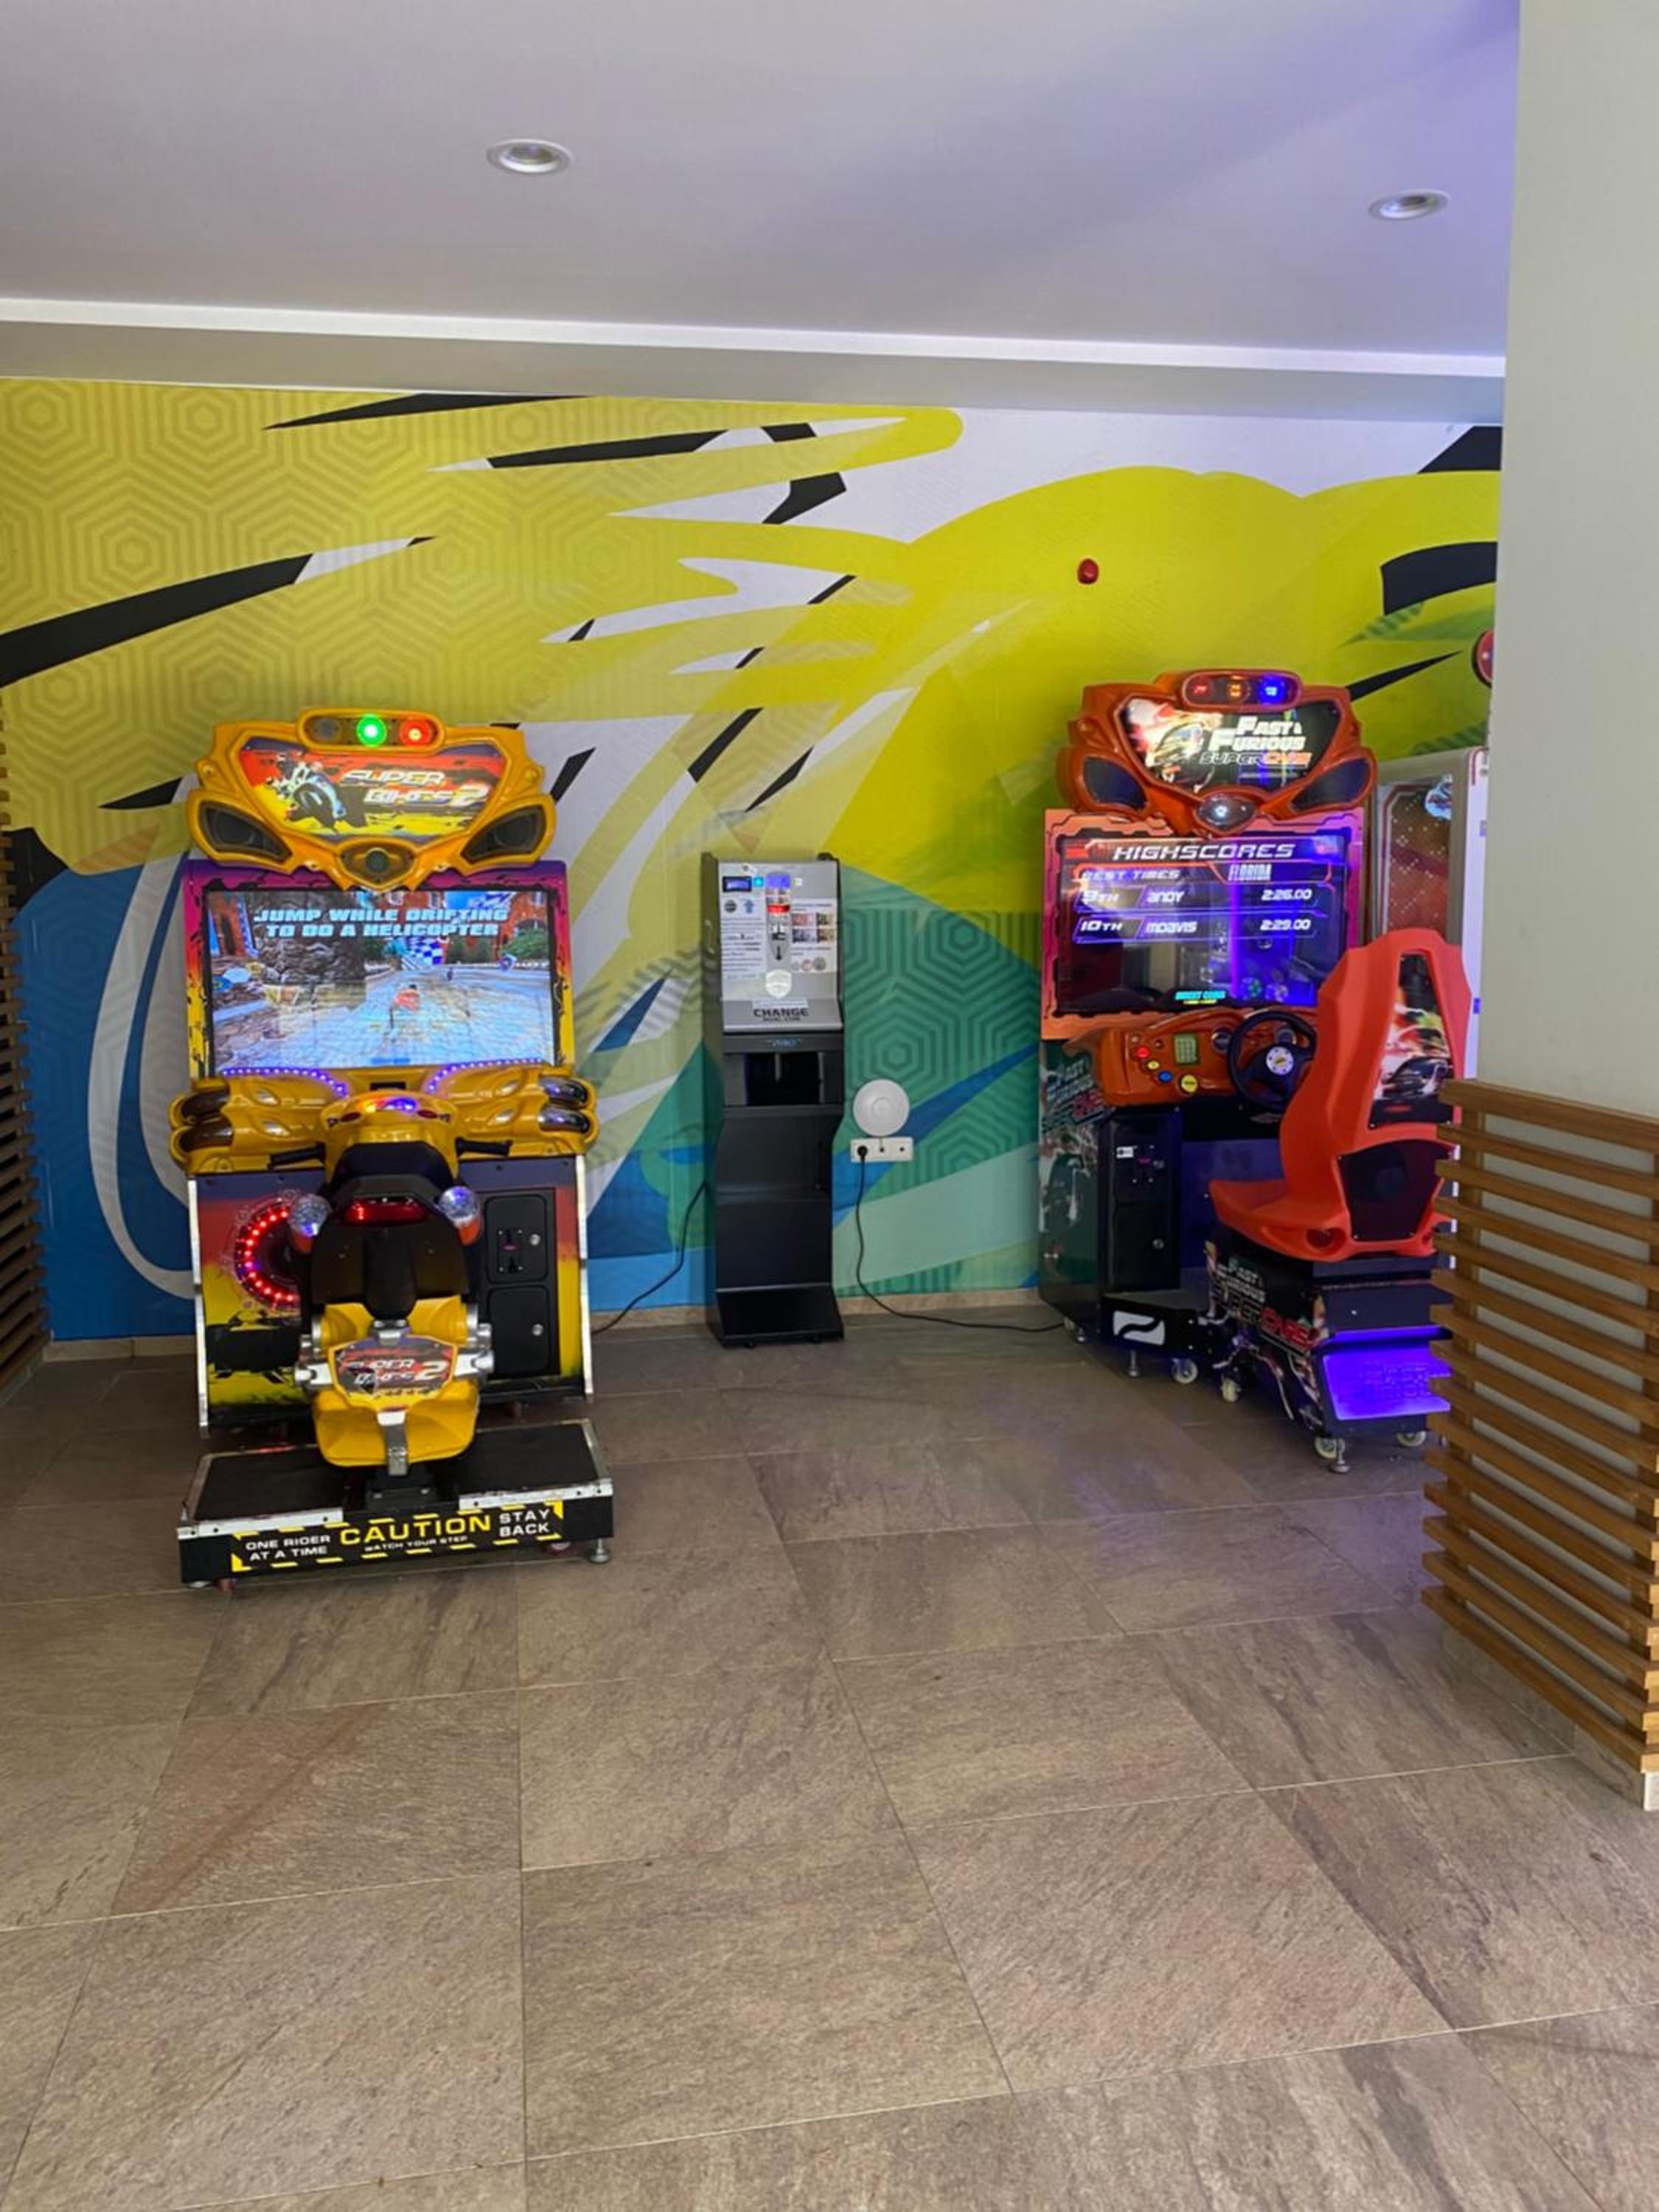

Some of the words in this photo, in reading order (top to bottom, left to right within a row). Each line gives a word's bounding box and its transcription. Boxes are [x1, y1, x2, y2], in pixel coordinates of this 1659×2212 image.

[1236, 716, 1293, 735] FAST
[1208, 729, 1307, 751] FURIOUS
[341, 769, 445, 786] SUPER
[1113, 844, 1296, 860] HIGHSCORES
[1130, 869, 1181, 880] TIMES
[254, 909, 322, 922] JUMP
[329, 908, 399, 922] WHILE
[406, 908, 509, 922] DRIFTING
[265, 924, 295, 937] TO
[302, 924, 334, 937] DO
[340, 924, 356, 936] A
[363, 923, 499, 936] HELICOPTER
[754, 1007, 809, 1018] CHANGE
[498, 1508, 551, 1524] STAY
[339, 1514, 491, 1545] CAUTION
[498, 1522, 550, 1538] BACK
[245, 1539, 279, 1551] ONE
[283, 1534, 331, 1548] RIDER
[364, 1541, 404, 1551] WATCH
[407, 1538, 437, 1548] YOUR
[439, 1535, 469, 1544] STEP
[248, 1551, 271, 1562] AT
[274, 1549, 286, 1559] A
[291, 1545, 327, 1557] TIME
